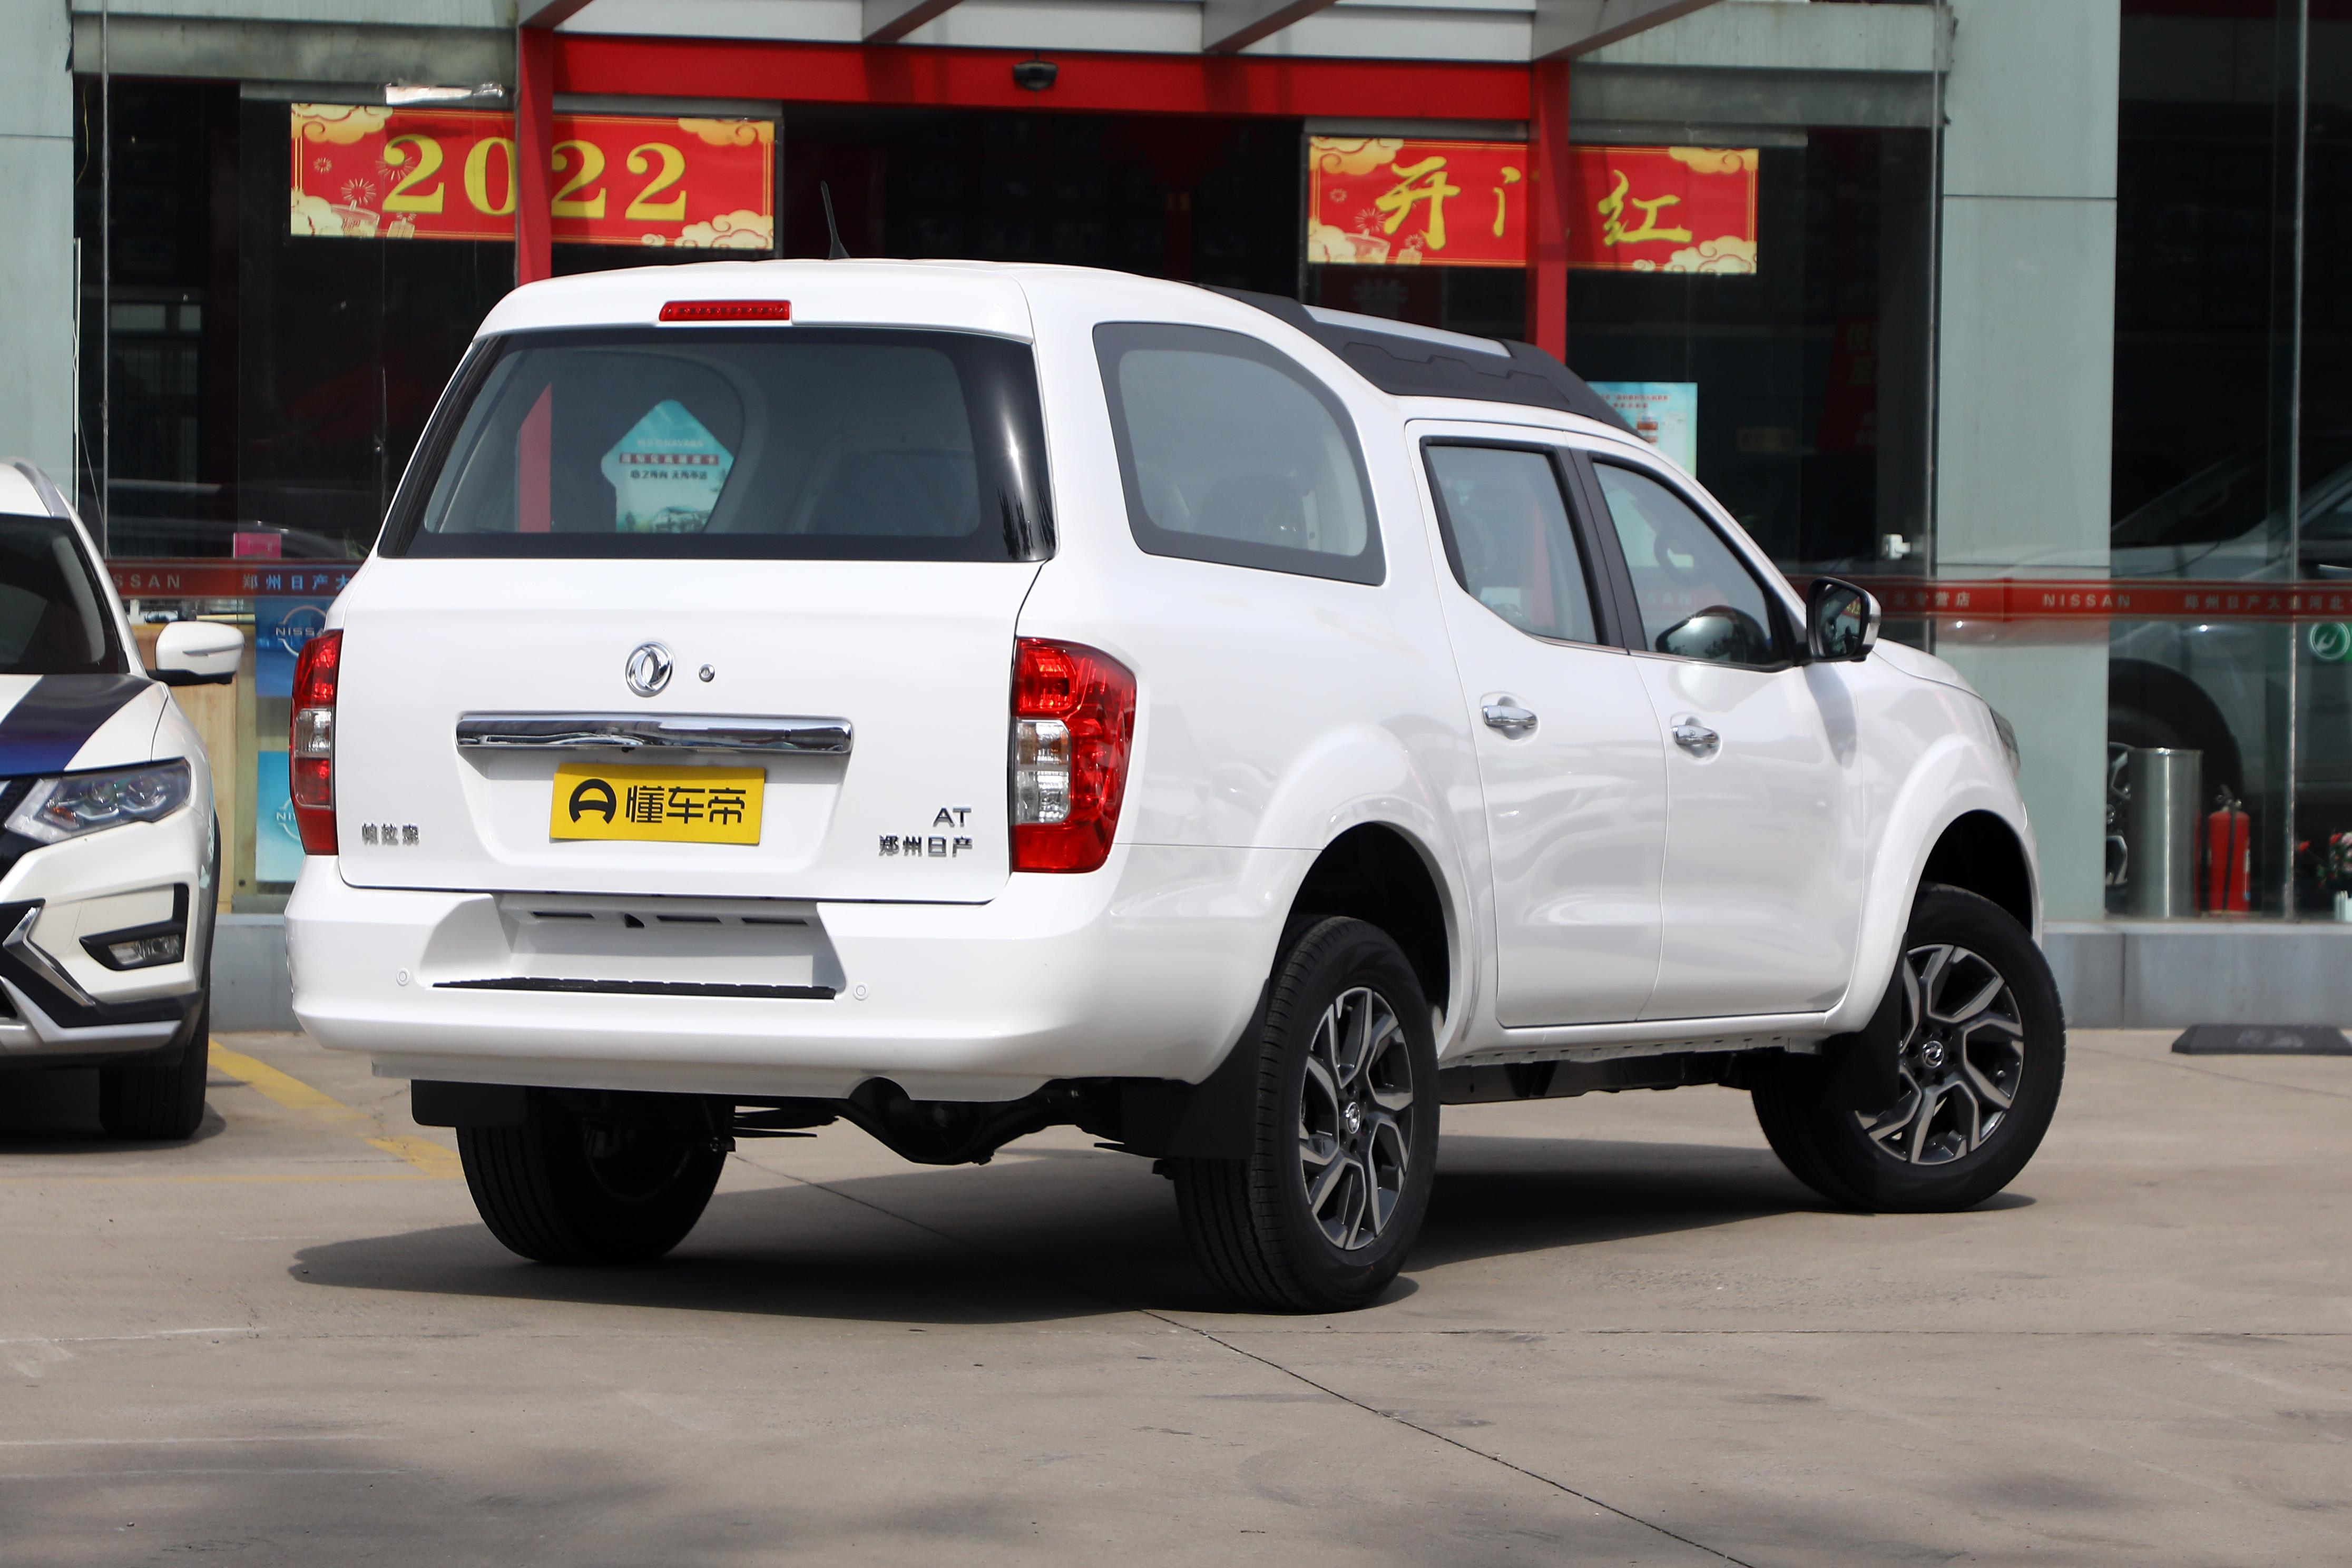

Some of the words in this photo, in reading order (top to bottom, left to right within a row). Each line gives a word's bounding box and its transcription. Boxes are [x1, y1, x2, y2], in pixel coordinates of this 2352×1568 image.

[382, 134, 688, 221] 2022
[2042, 593, 2132, 607] NISSAN
[2183, 594, 2352, 611] 郑州日产大河北
[625, 785, 747, 825] 懂车帝
[276, 811, 295, 822] NI
[933, 806, 972, 827] AT
[878, 834, 973, 858] 郑州日产
